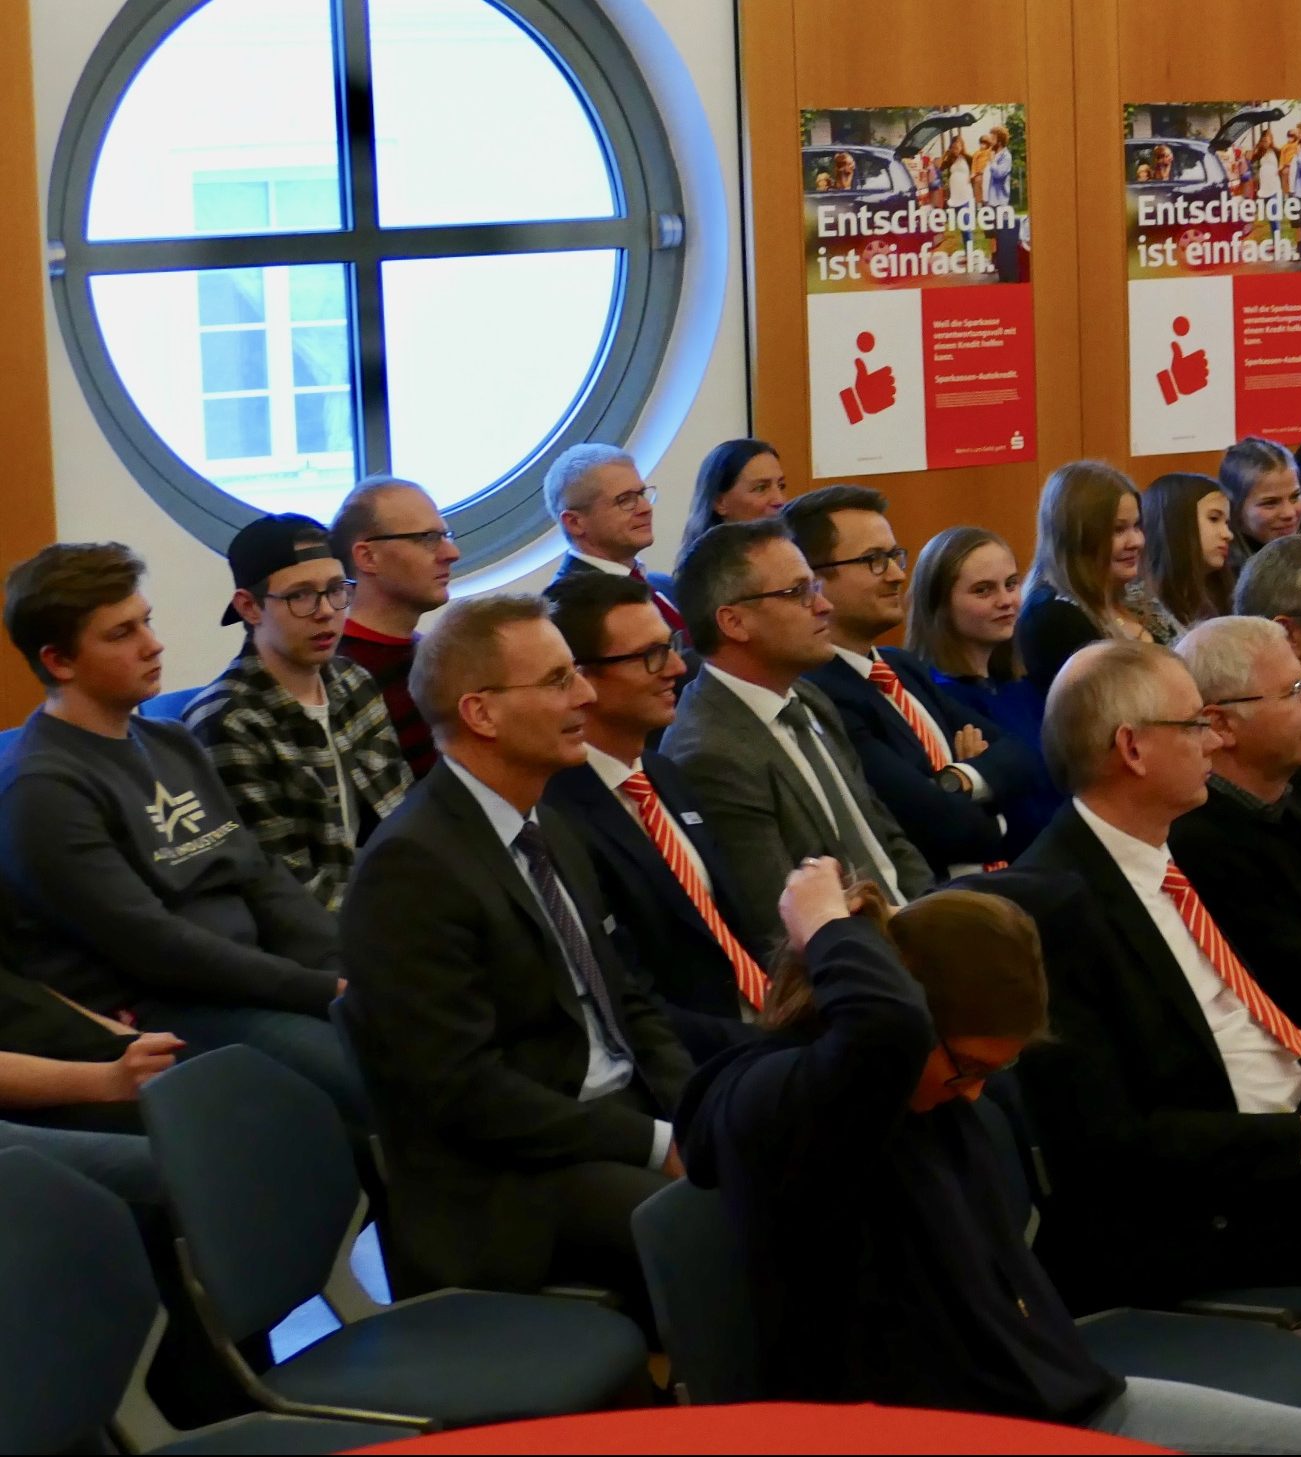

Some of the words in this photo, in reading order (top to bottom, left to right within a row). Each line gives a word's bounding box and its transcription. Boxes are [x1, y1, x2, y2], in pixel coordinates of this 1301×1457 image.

[817, 199, 1015, 238] Entscheiden
[817, 246, 862, 281] ist
[869, 240, 996, 278] einfach.
[1136, 234, 1178, 268] ist
[1186, 229, 1301, 266] einfach.
